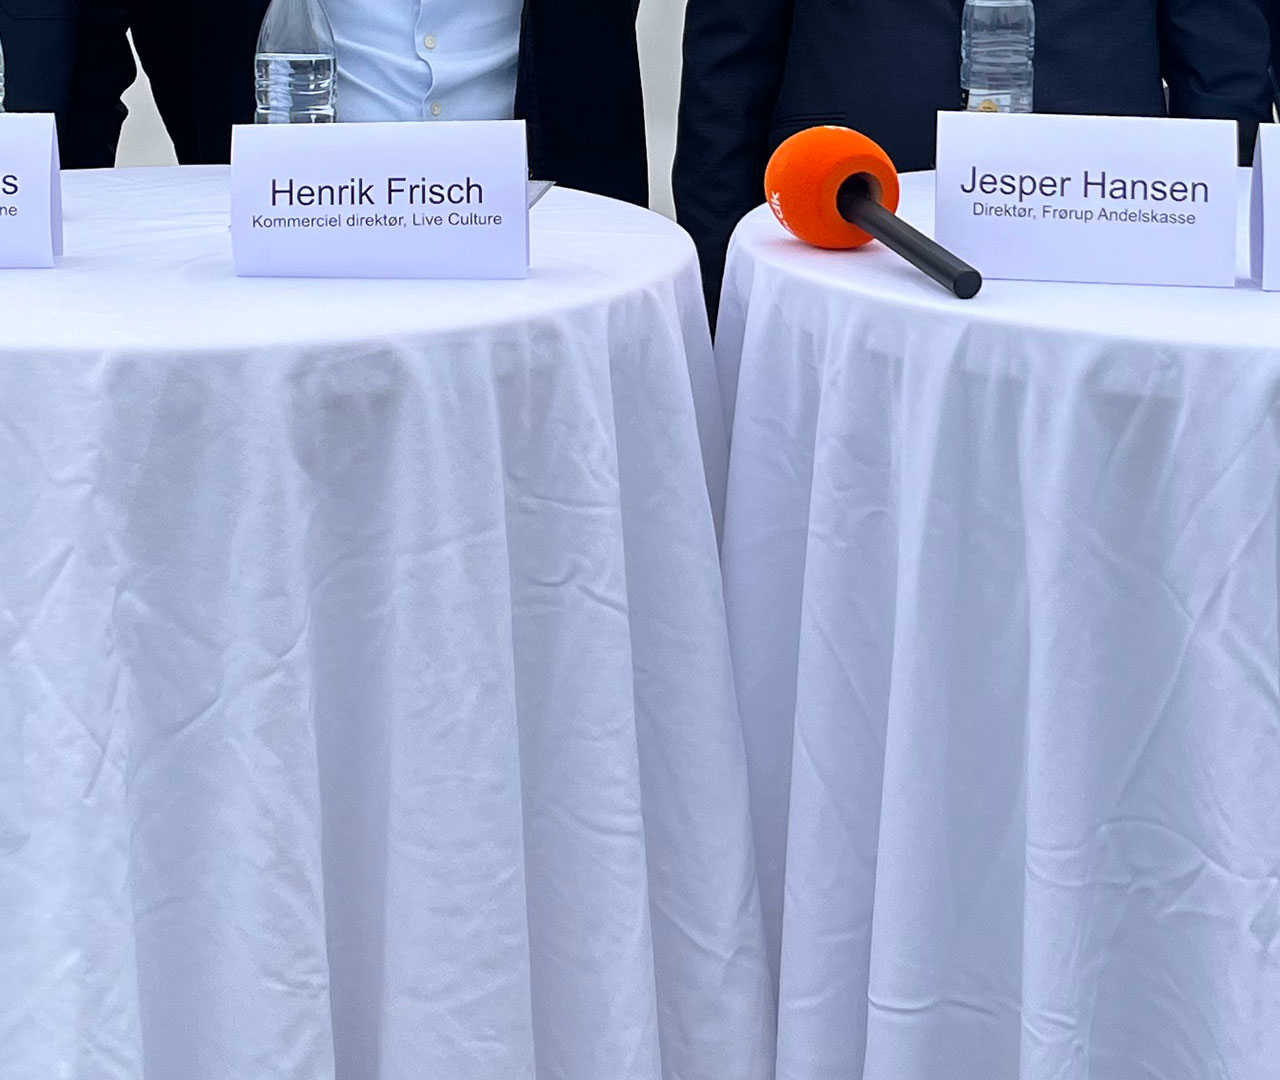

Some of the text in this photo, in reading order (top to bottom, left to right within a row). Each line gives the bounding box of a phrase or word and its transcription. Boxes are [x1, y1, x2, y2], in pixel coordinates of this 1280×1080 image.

[272, 177, 483, 206] Henrik Frisch
[960, 166, 1209, 202] Jesper Hansen
[252, 213, 502, 228] Kommerciel direktør, Live Culture
[973, 202, 1195, 224] Direktør, Frørup Andelskasse
